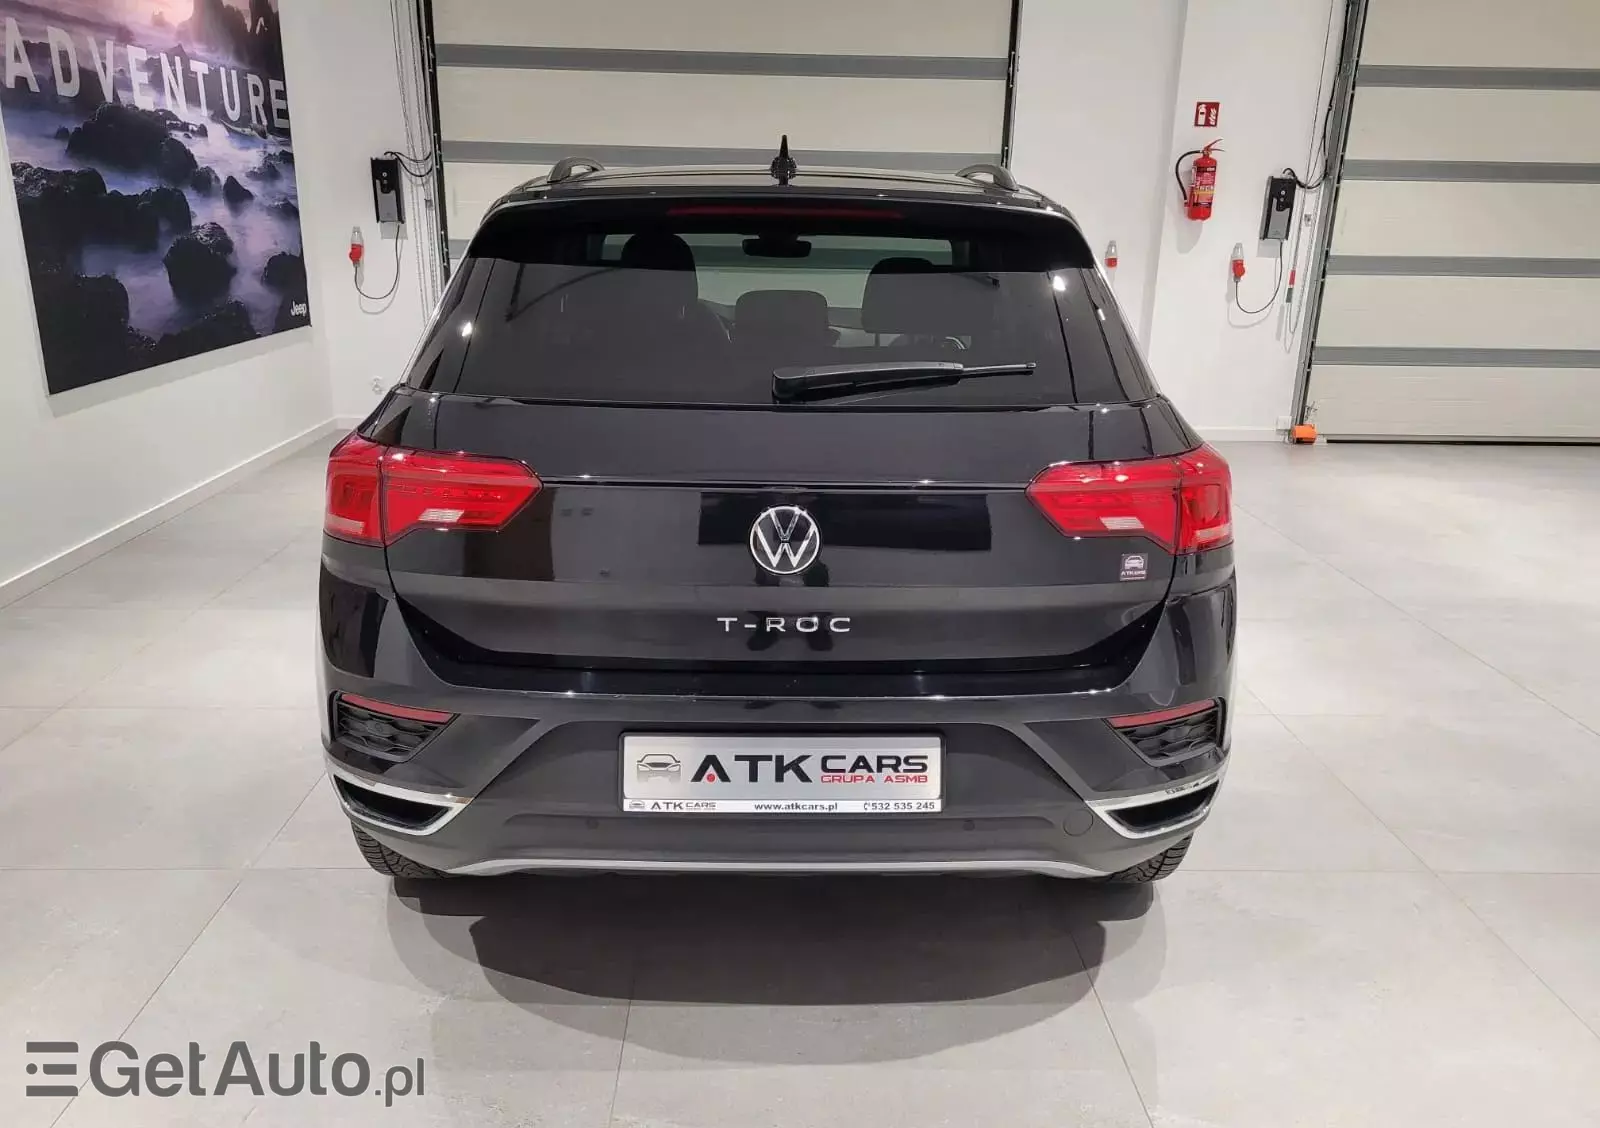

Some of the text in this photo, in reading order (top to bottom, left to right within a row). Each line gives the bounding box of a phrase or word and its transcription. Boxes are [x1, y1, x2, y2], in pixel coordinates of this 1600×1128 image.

[4, 17, 290, 129] ADVENTURE
[290, 300, 307, 317] Jeep
[716, 617, 851, 632] T-ROC
[690, 754, 929, 783] ATK CARS
[820, 774, 929, 783] GRUPA ASMB
[650, 801, 683, 810] ATK
[754, 802, 838, 812] www.atkcars.pl
[871, 801, 935, 810] 532 535 245
